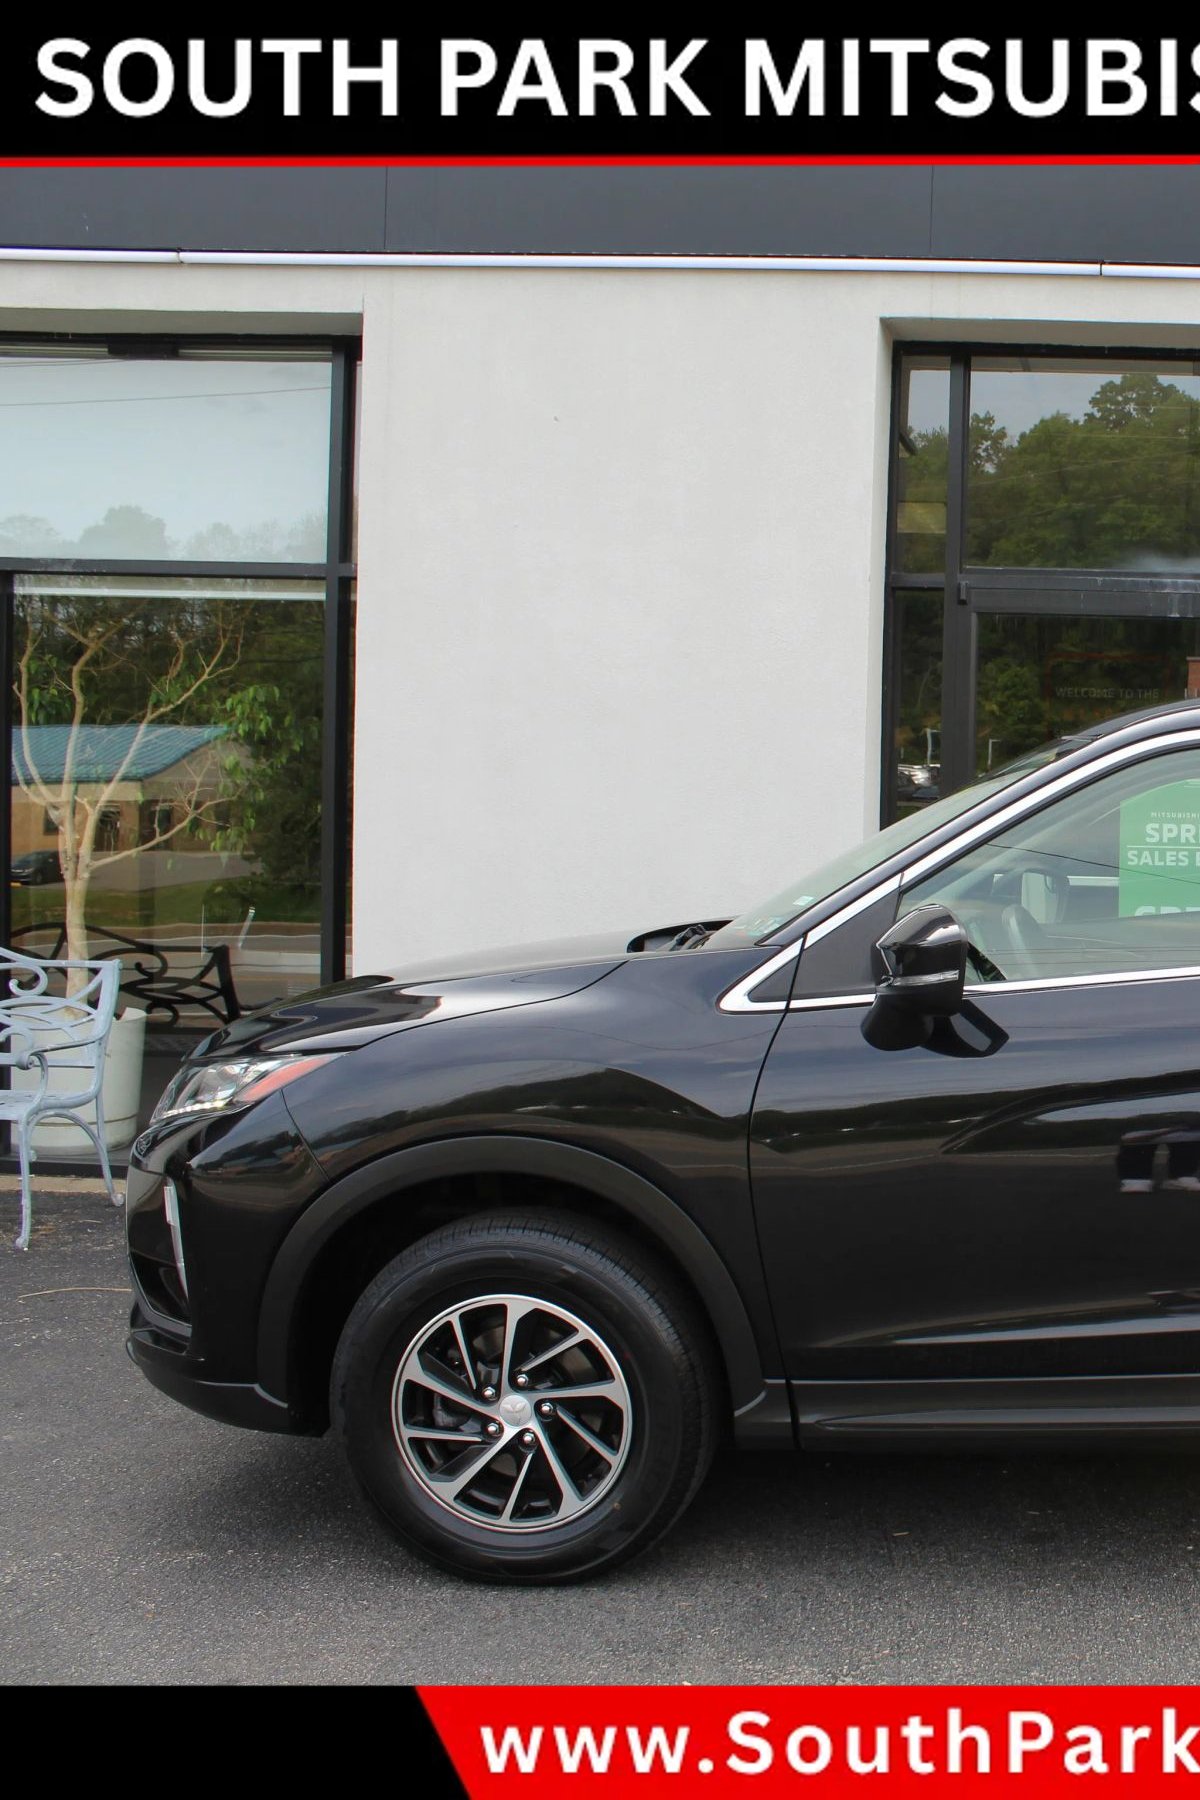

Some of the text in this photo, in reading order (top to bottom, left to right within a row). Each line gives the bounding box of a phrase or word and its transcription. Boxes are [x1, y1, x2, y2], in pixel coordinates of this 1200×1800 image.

[1055, 687, 1160, 699] WELCOME TO THE
[1150, 811, 1200, 819] MITSUBISHI
[1127, 850, 1189, 867] SALES
